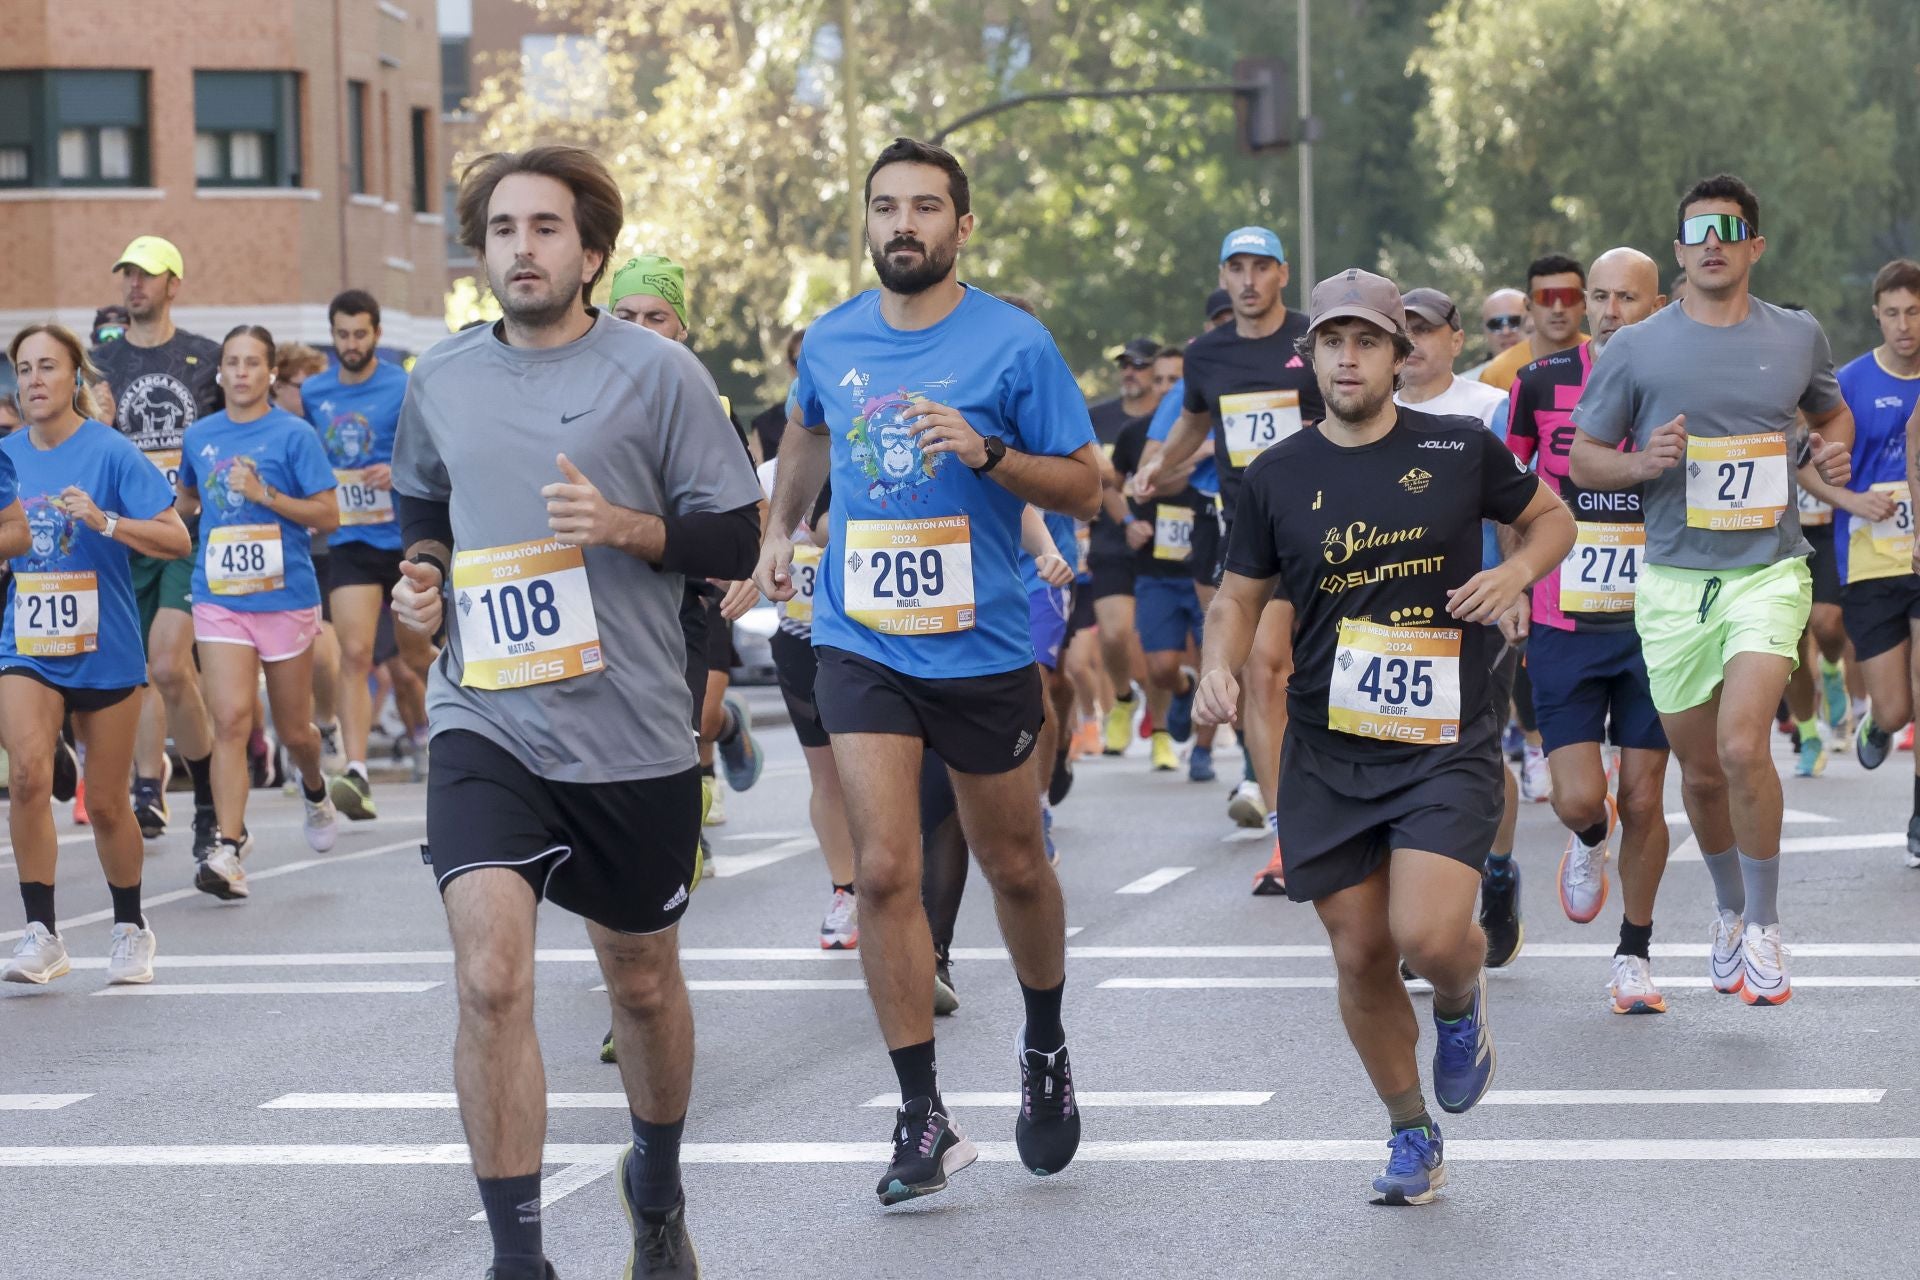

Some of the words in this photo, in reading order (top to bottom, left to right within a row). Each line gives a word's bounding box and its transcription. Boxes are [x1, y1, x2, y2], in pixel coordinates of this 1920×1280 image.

[1246, 411, 1276, 442] 73
[1727, 449, 1746, 457] 2024
[1718, 461, 1755, 501] 27
[1577, 492, 1640, 511] GINES
[871, 524, 894, 532] MEDIA
[894, 519, 937, 531] MARATÓN
[937, 518, 966, 528] AVILÉS
[1325, 526, 1342, 542] La
[891, 534, 918, 545] 2024
[1320, 521, 1428, 565] Solana
[221, 543, 265, 572] 438
[493, 544, 541, 563] MARATÓN
[491, 563, 521, 579] 2024
[870, 548, 944, 598] 269
[1346, 555, 1445, 588] SUMMIT
[1581, 546, 1638, 584] 274
[27, 594, 78, 629] 219
[480, 579, 561, 645] 108
[896, 598, 922, 608] MIGUEL
[878, 614, 944, 632] avilés
[1391, 629, 1431, 640] MARATÓN
[507, 641, 536, 655] MATIAS
[1386, 641, 1413, 652] 2024
[496, 658, 565, 686] avilés
[1357, 656, 1433, 708] 435
[1379, 704, 1409, 716] DIEGOFF
[1358, 720, 1427, 741] avilés
